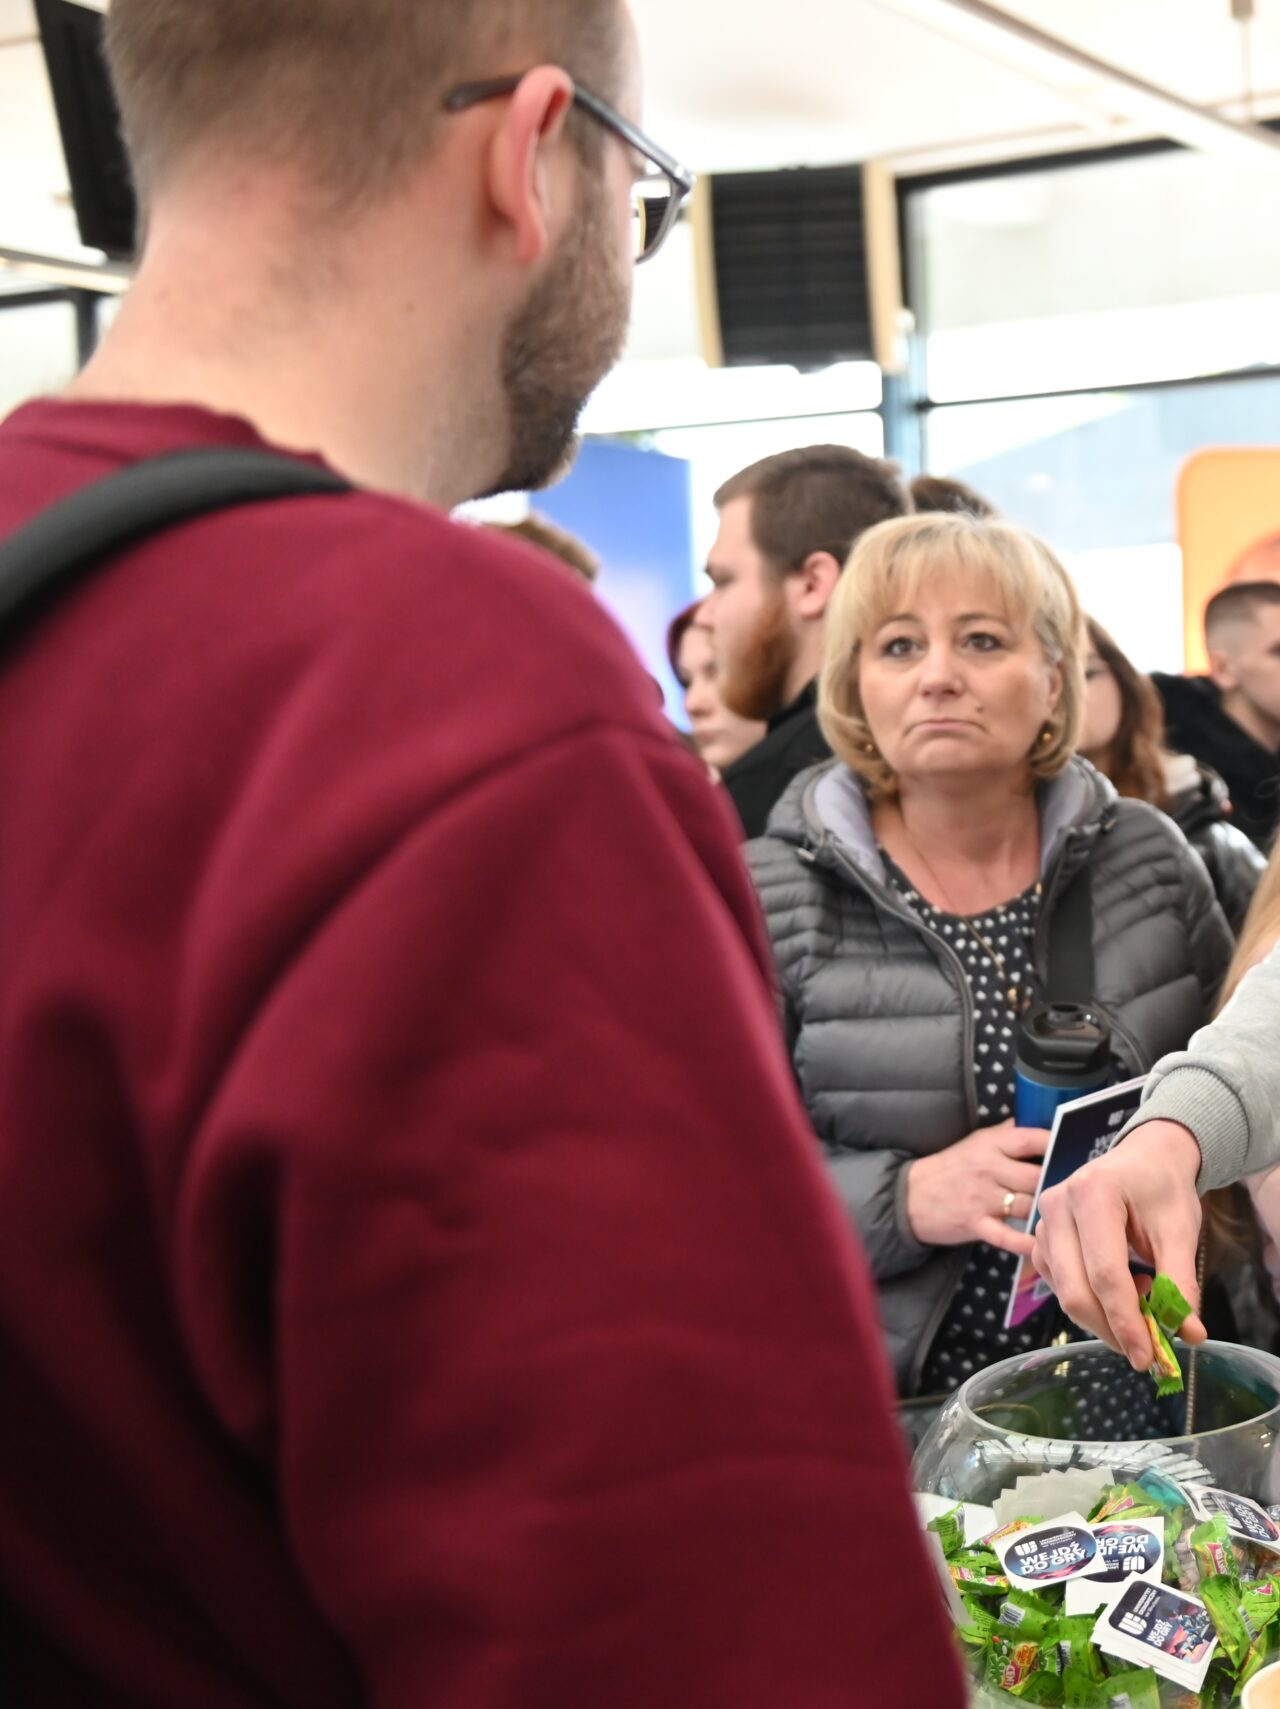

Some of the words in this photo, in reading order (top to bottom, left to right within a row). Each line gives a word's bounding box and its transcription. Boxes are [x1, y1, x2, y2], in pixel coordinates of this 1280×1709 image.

[1122, 1535, 1148, 1545] DO
[1020, 1541, 1082, 1566] WEJDŹ
[1020, 1560, 1048, 1575] DO
[1051, 1548, 1086, 1565] GRY
